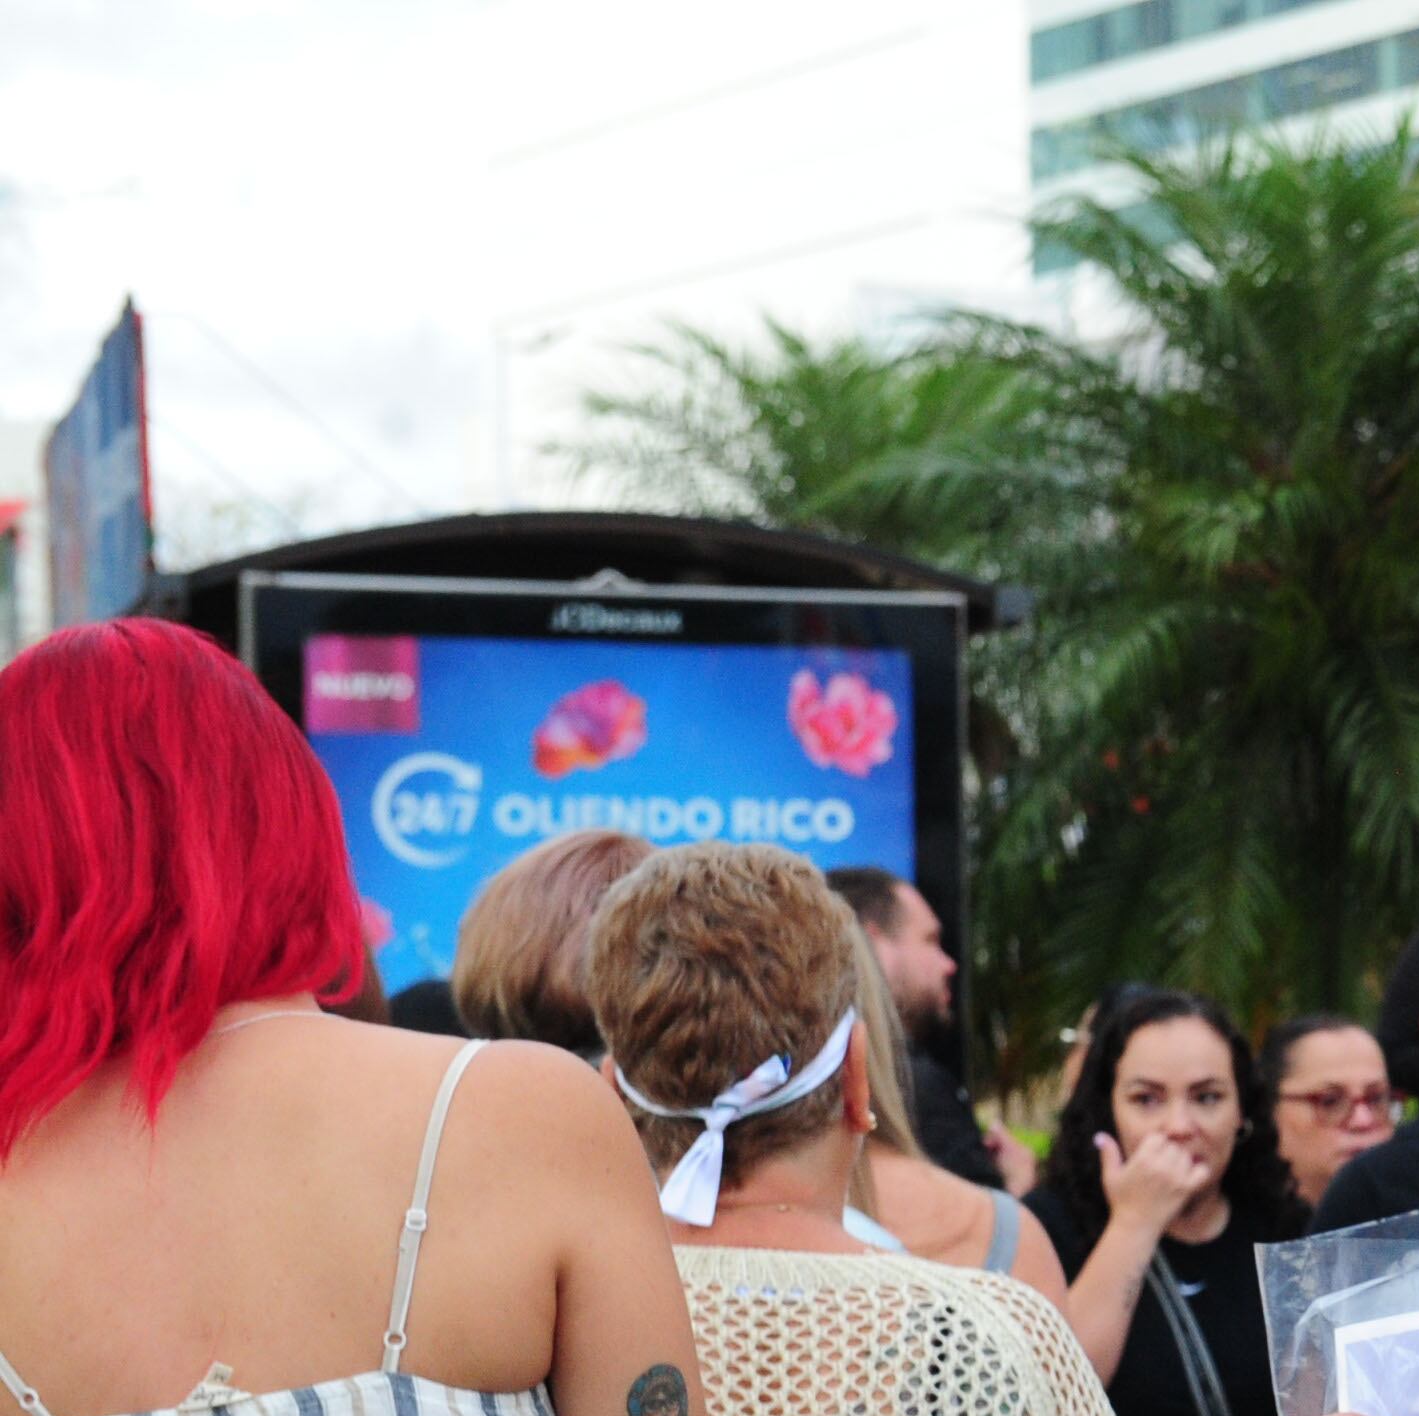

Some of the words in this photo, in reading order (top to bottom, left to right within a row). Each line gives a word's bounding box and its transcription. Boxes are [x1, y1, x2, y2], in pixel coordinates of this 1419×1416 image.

[312, 671, 415, 701] NUEVO
[493, 795, 723, 841] OLIENDO
[731, 798, 856, 842] RICO
